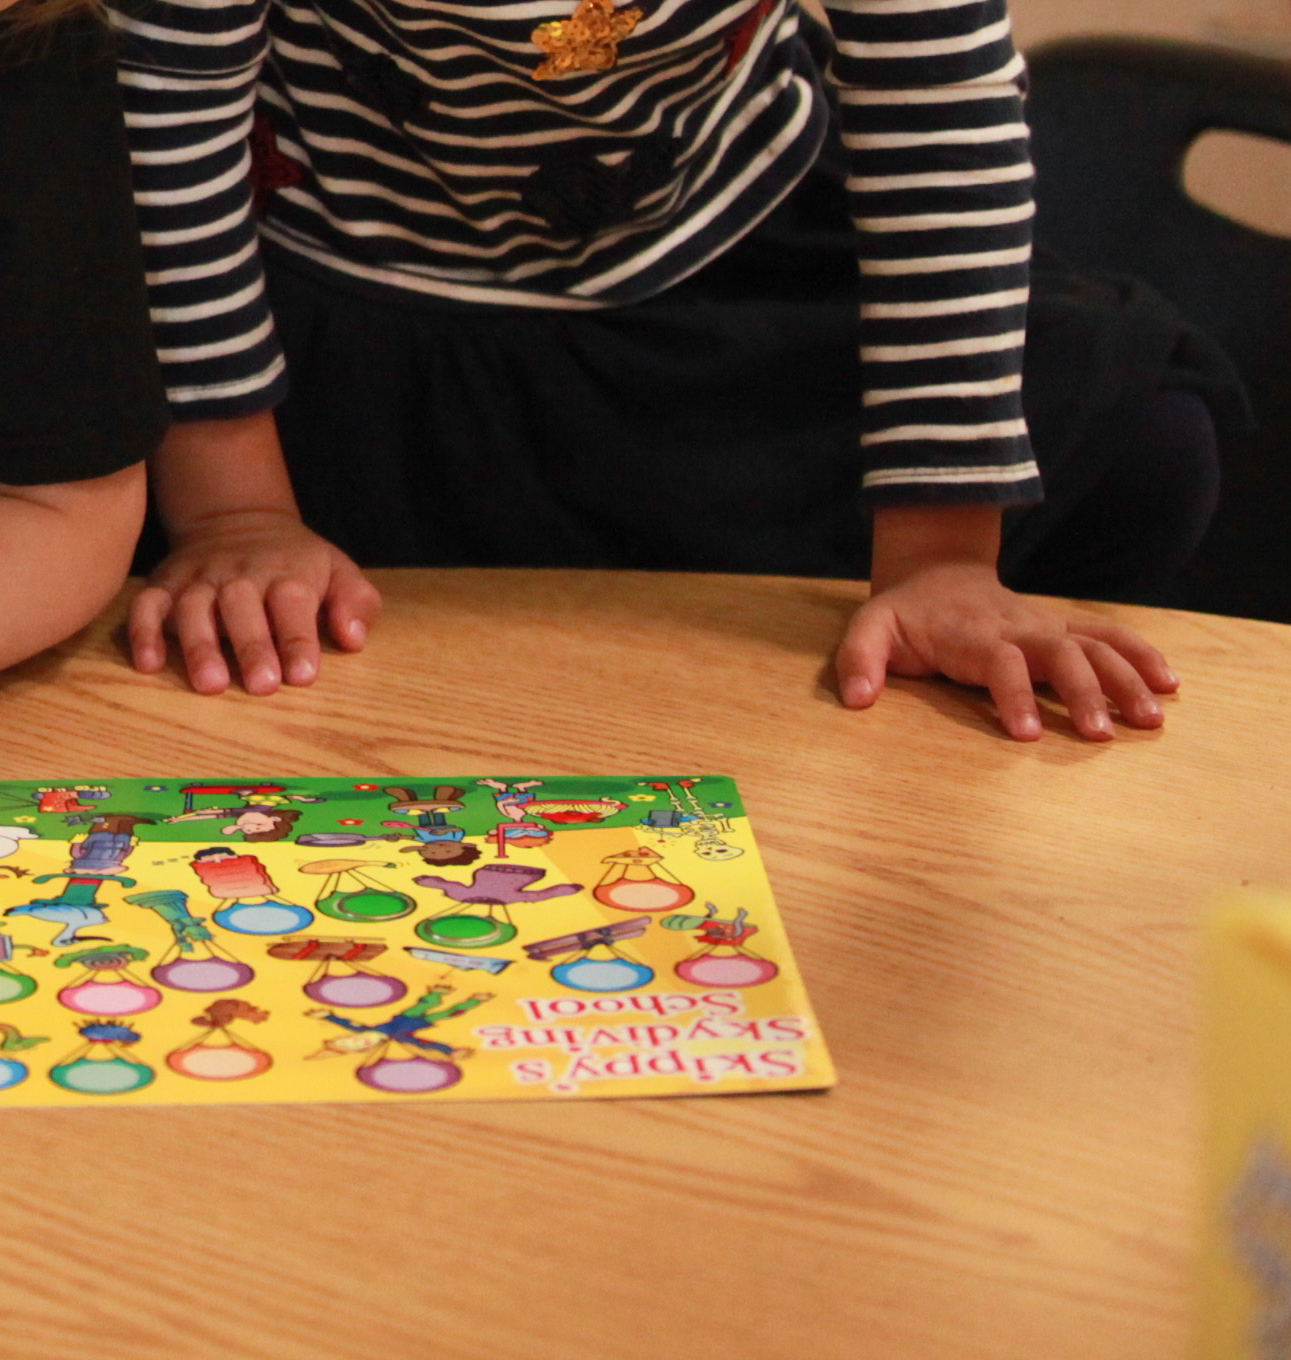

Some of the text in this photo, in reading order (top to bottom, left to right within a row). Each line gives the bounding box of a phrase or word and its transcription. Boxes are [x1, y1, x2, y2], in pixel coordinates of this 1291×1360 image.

[523, 992, 740, 1021] School
[478, 1017, 806, 1052] Skydiving
[515, 1050, 797, 1092] Skippy's
